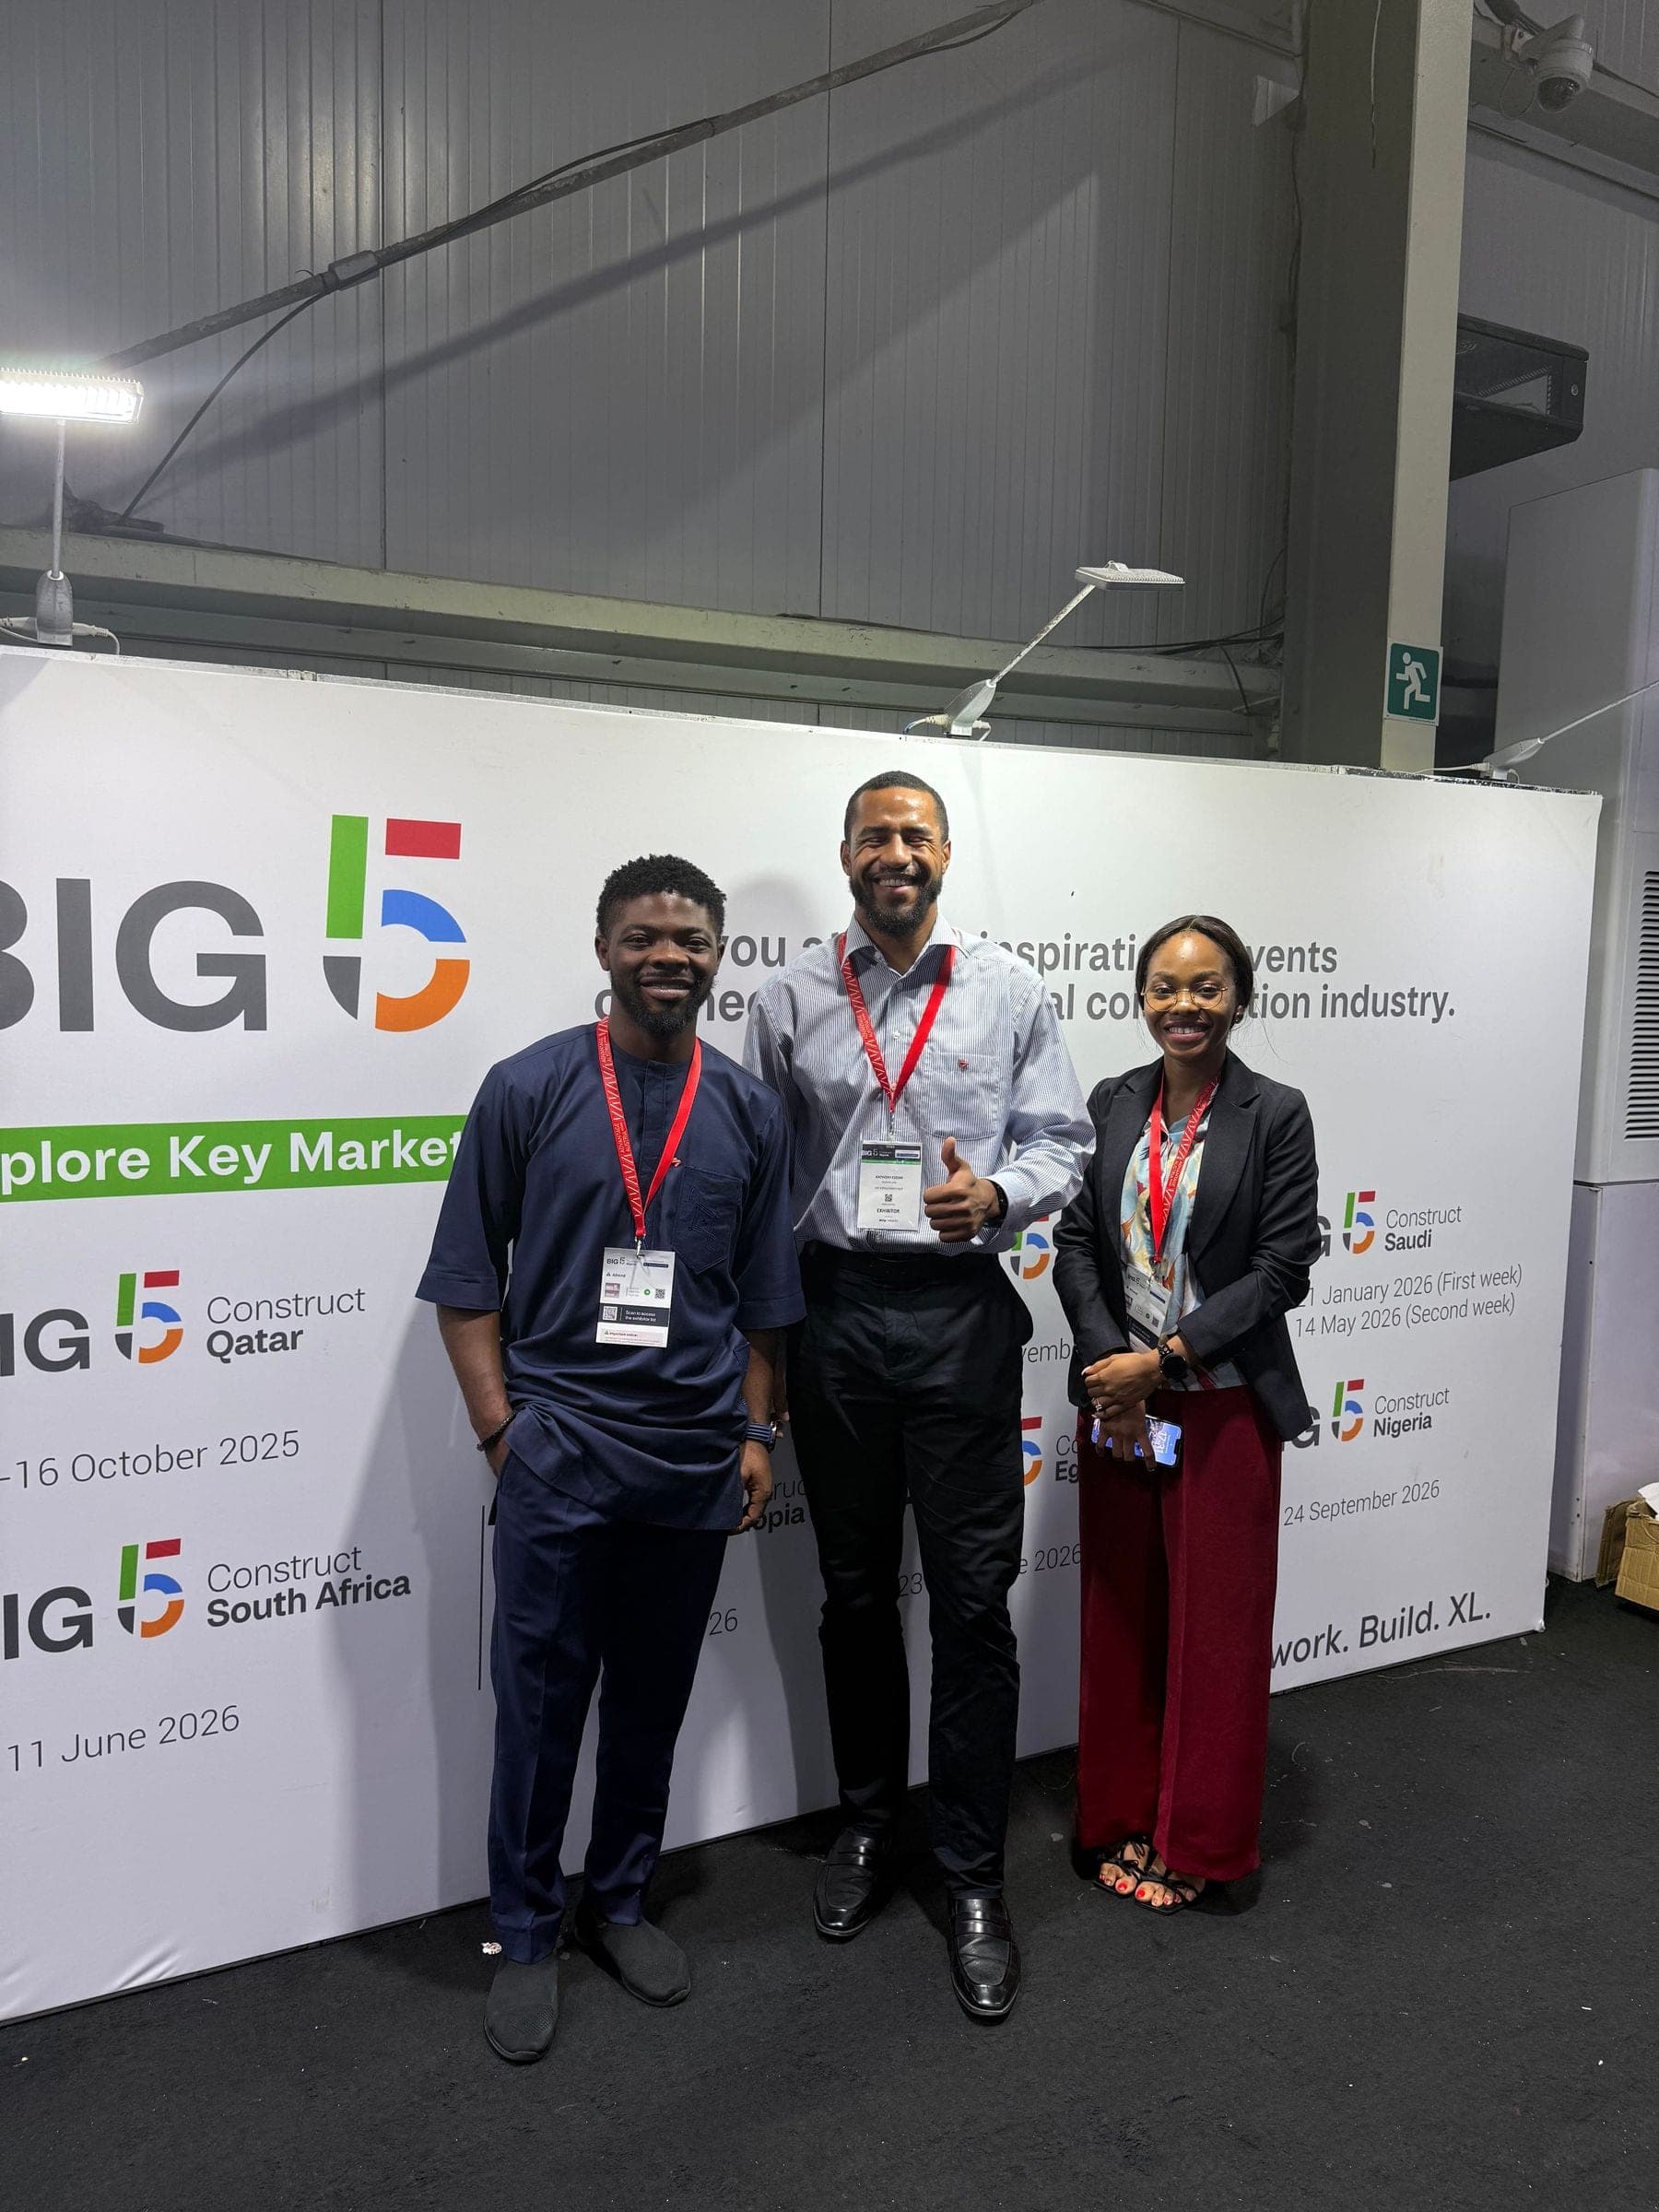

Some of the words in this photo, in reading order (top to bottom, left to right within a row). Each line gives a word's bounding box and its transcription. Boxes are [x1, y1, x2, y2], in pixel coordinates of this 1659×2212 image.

[324, 815, 470, 1033] 5
[720, 935, 785, 968] ou
[1246, 941, 1338, 973] vents
[1321, 984, 1455, 1024] industry.
[170, 1135, 273, 1185] Key
[1343, 1191, 1376, 1254] 5
[1386, 1206, 1463, 1229] Construct
[1384, 1229, 1432, 1251] Saudi
[1322, 1282, 1389, 1306] January
[1394, 1275, 1433, 1299] 2026
[1437, 1271, 1477, 1296] (First
[1480, 1264, 1523, 1288] week)
[115, 1270, 183, 1364] 5
[207, 1288, 366, 1325] Construct
[1296, 1316, 1316, 1337] 14
[1321, 1314, 1357, 1336] May
[1361, 1307, 1401, 1330] 2026
[1406, 1299, 1468, 1329] (Second
[1473, 1292, 1516, 1316] week)
[206, 1328, 304, 1364] Qatar
[1331, 1379, 1364, 1441] 5
[1374, 1387, 1450, 1415] Construct
[1373, 1412, 1432, 1439] Nigeria
[72, 1444, 208, 1483] October
[219, 1430, 300, 1465] 2025
[1284, 1504, 1305, 1526] 24
[1309, 1490, 1398, 1522] September
[1402, 1479, 1440, 1504] 2026
[1034, 1543, 1081, 1571] 2026
[117, 1537, 184, 1638] 5
[207, 1547, 362, 1593] Construct
[206, 1585, 306, 1629] South
[315, 1572, 411, 1610] Africa
[1359, 1600, 1440, 1648] Build.
[1447, 1592, 1490, 1627] XL.
[7, 1740, 42, 1771] 11
[62, 1729, 147, 1762] June
[159, 1705, 240, 1745] 2026
